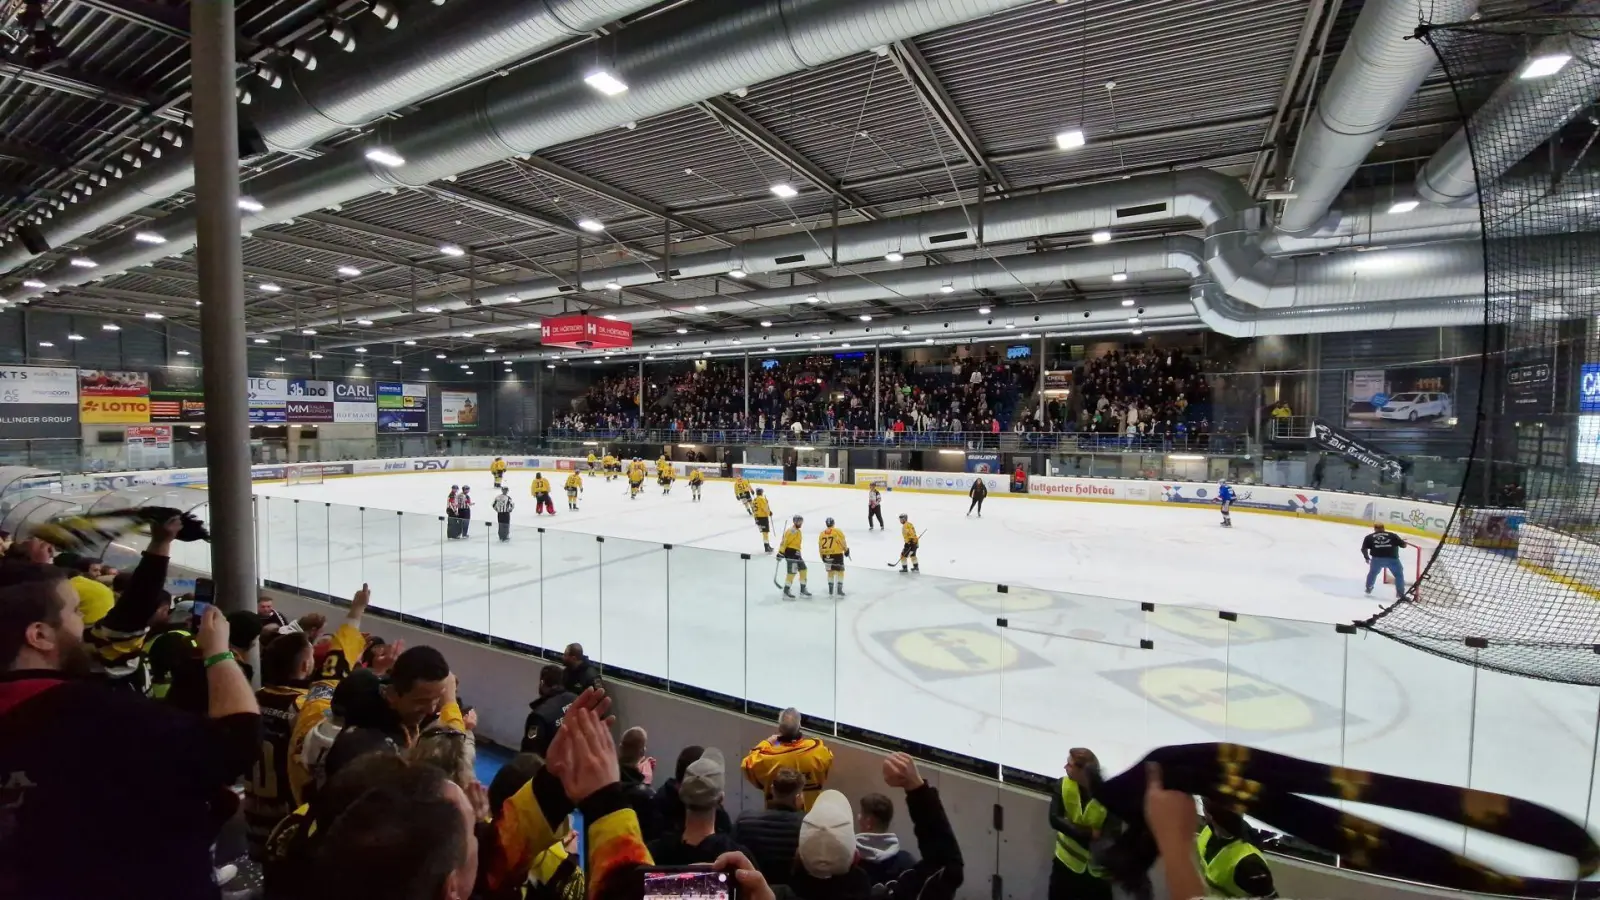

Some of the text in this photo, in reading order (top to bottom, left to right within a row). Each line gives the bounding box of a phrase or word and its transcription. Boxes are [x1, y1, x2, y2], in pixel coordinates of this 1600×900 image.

[336, 384, 374, 397] CARL
[101, 402, 147, 412] LOTTO
[1327, 436, 1346, 451] Die
[1347, 446, 1380, 469] Treuen
[414, 460, 450, 471] DSV
[1075, 483, 1115, 496] Hofbräu
[821, 536, 834, 549] 27
